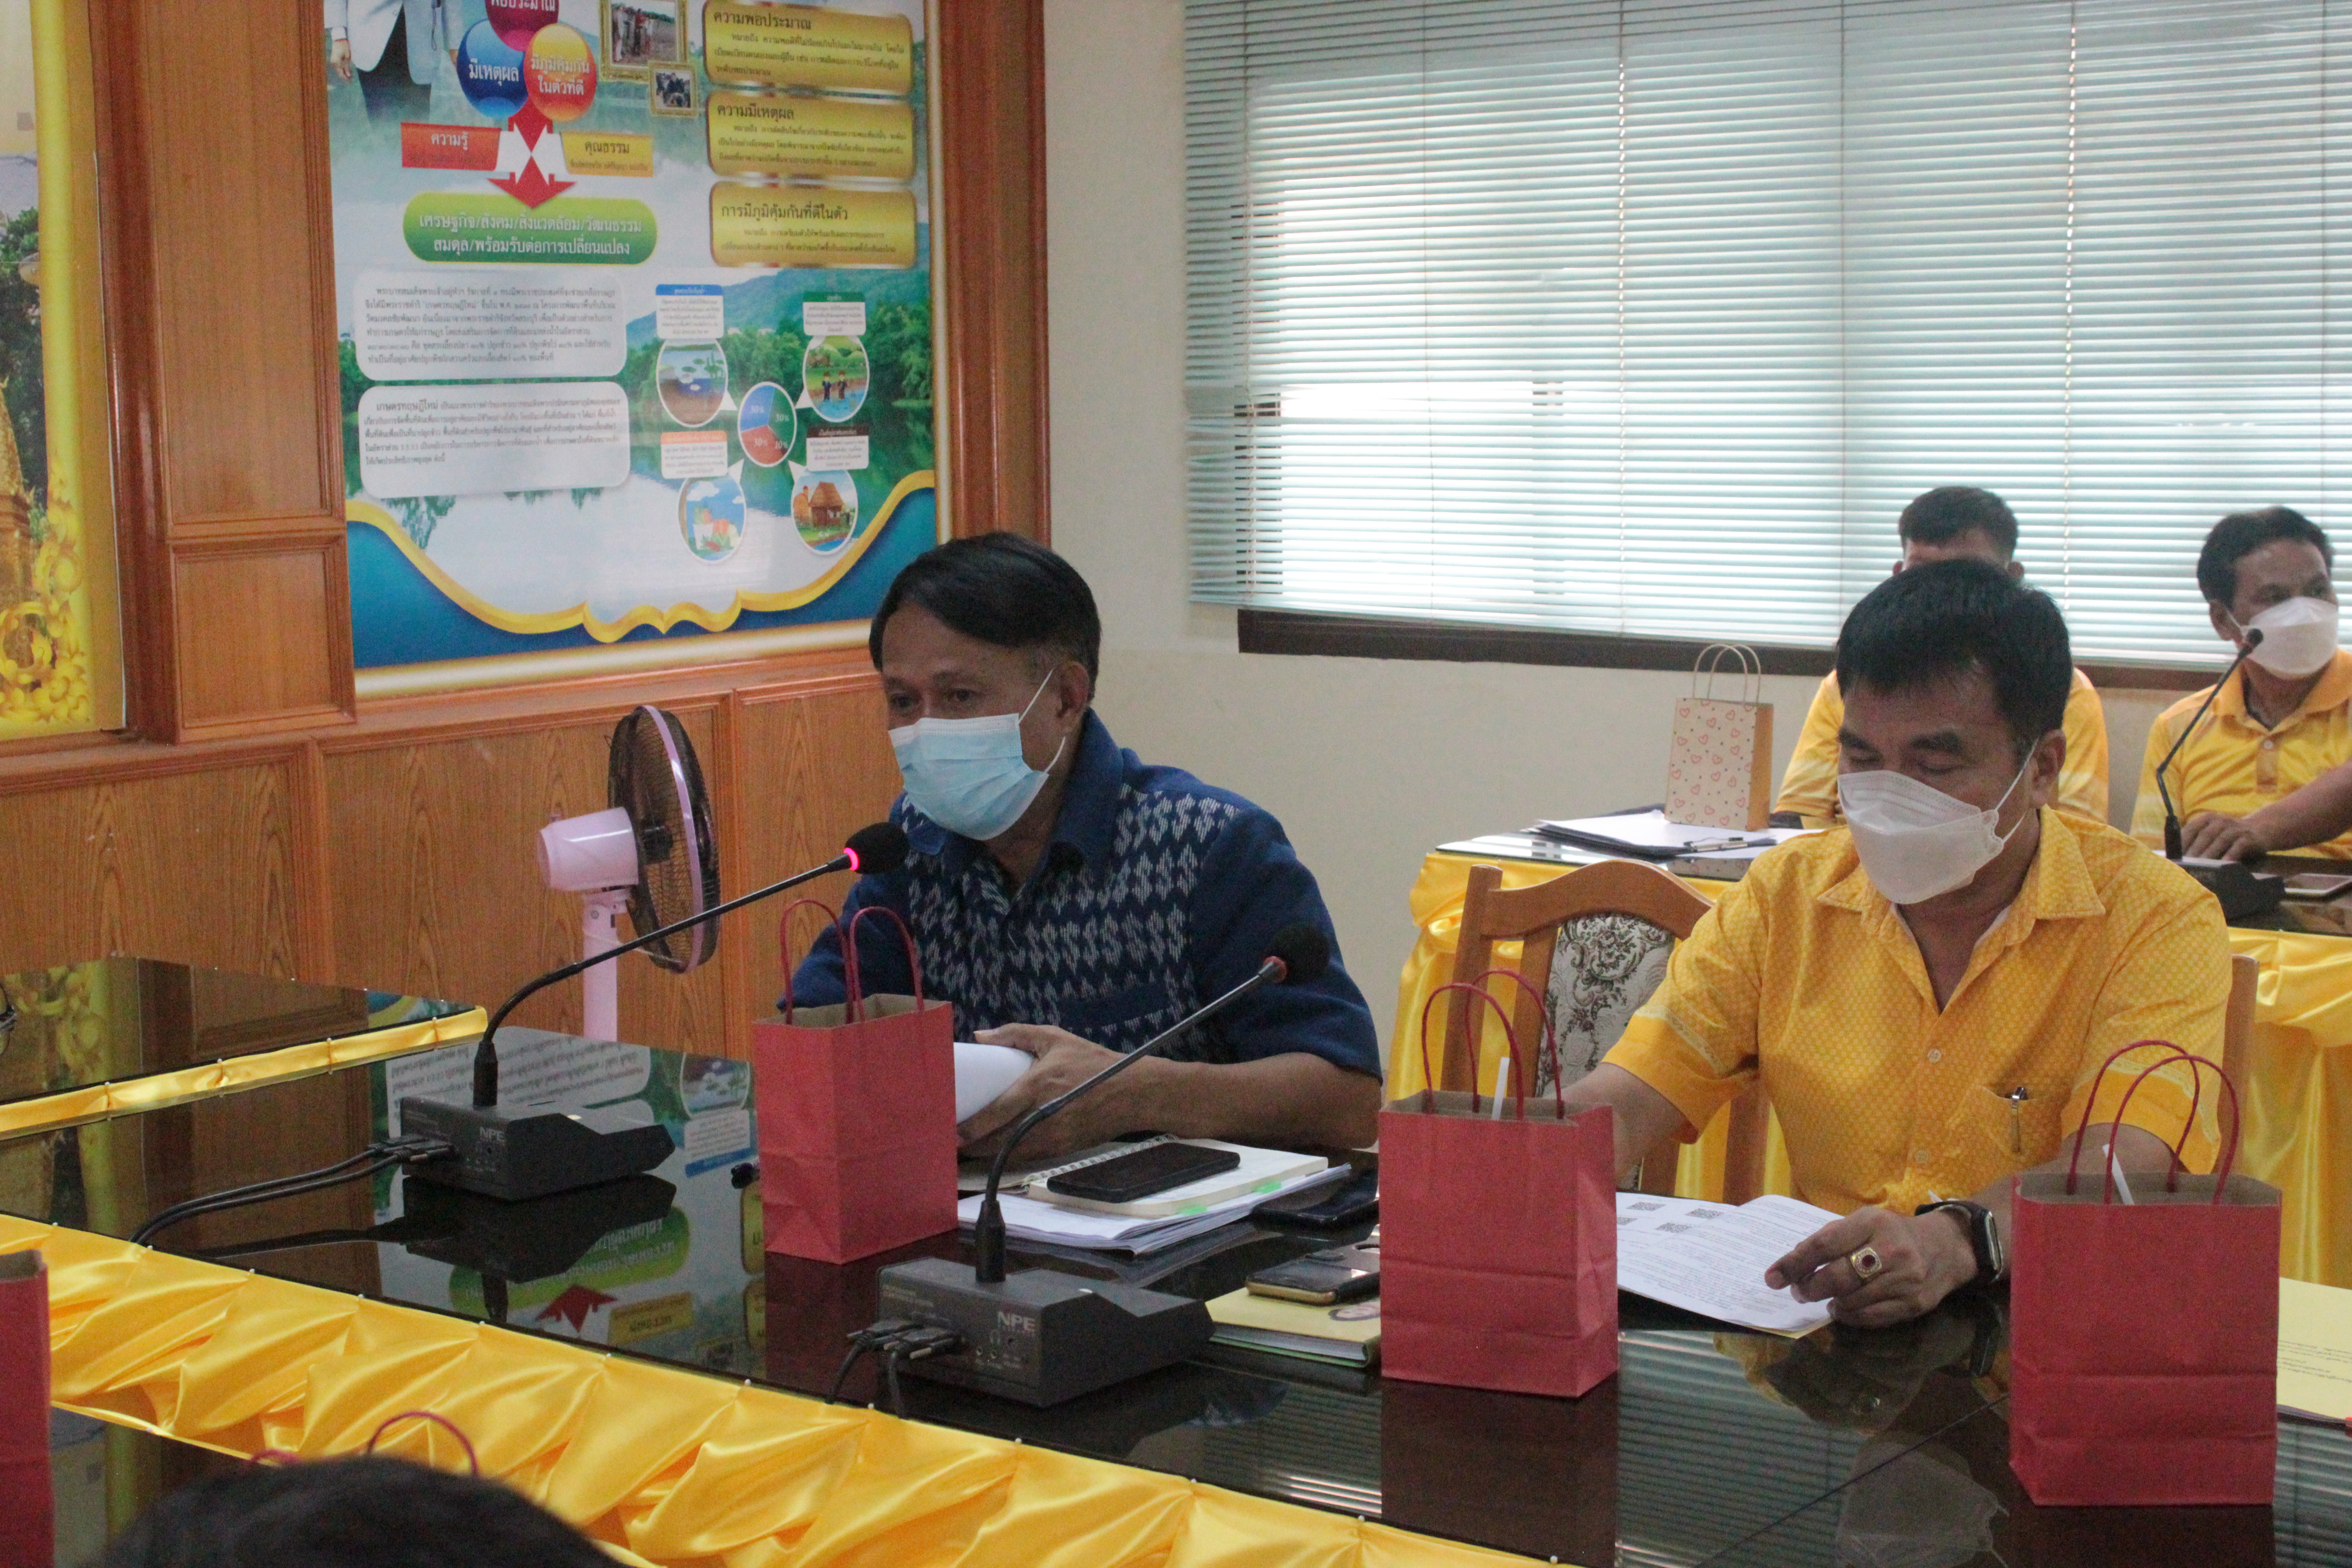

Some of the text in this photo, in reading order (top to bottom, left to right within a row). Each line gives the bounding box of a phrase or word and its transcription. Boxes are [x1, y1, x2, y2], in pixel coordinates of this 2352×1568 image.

[714, 11, 812, 30] ความพอประมาณ
[469, 58, 519, 86] มีเหตุผล
[531, 54, 590, 75] มีภูมิคุ้มกัน
[538, 74, 584, 95] ในตัวที่ดี
[717, 103, 794, 122] ความมีเหตุผล
[431, 132, 468, 151] ความรู้
[584, 141, 629, 156] คุณธรรม
[419, 208, 642, 233] เศรษฐกิจ/สังคม/สิ่งแวดล้อม/วัฒนธรรม
[721, 201, 848, 222] การมีภูมิคุ้มกันที่ดีในตัว
[434, 233, 630, 256] สมดุล/พร้อมรับต่อการเปลี่ยนแปลง
[376, 398, 439, 412] เกษตรทฤษฎีใหม่
[479, 1126, 505, 1142] NPE
[998, 1311, 1036, 1333] NPE
